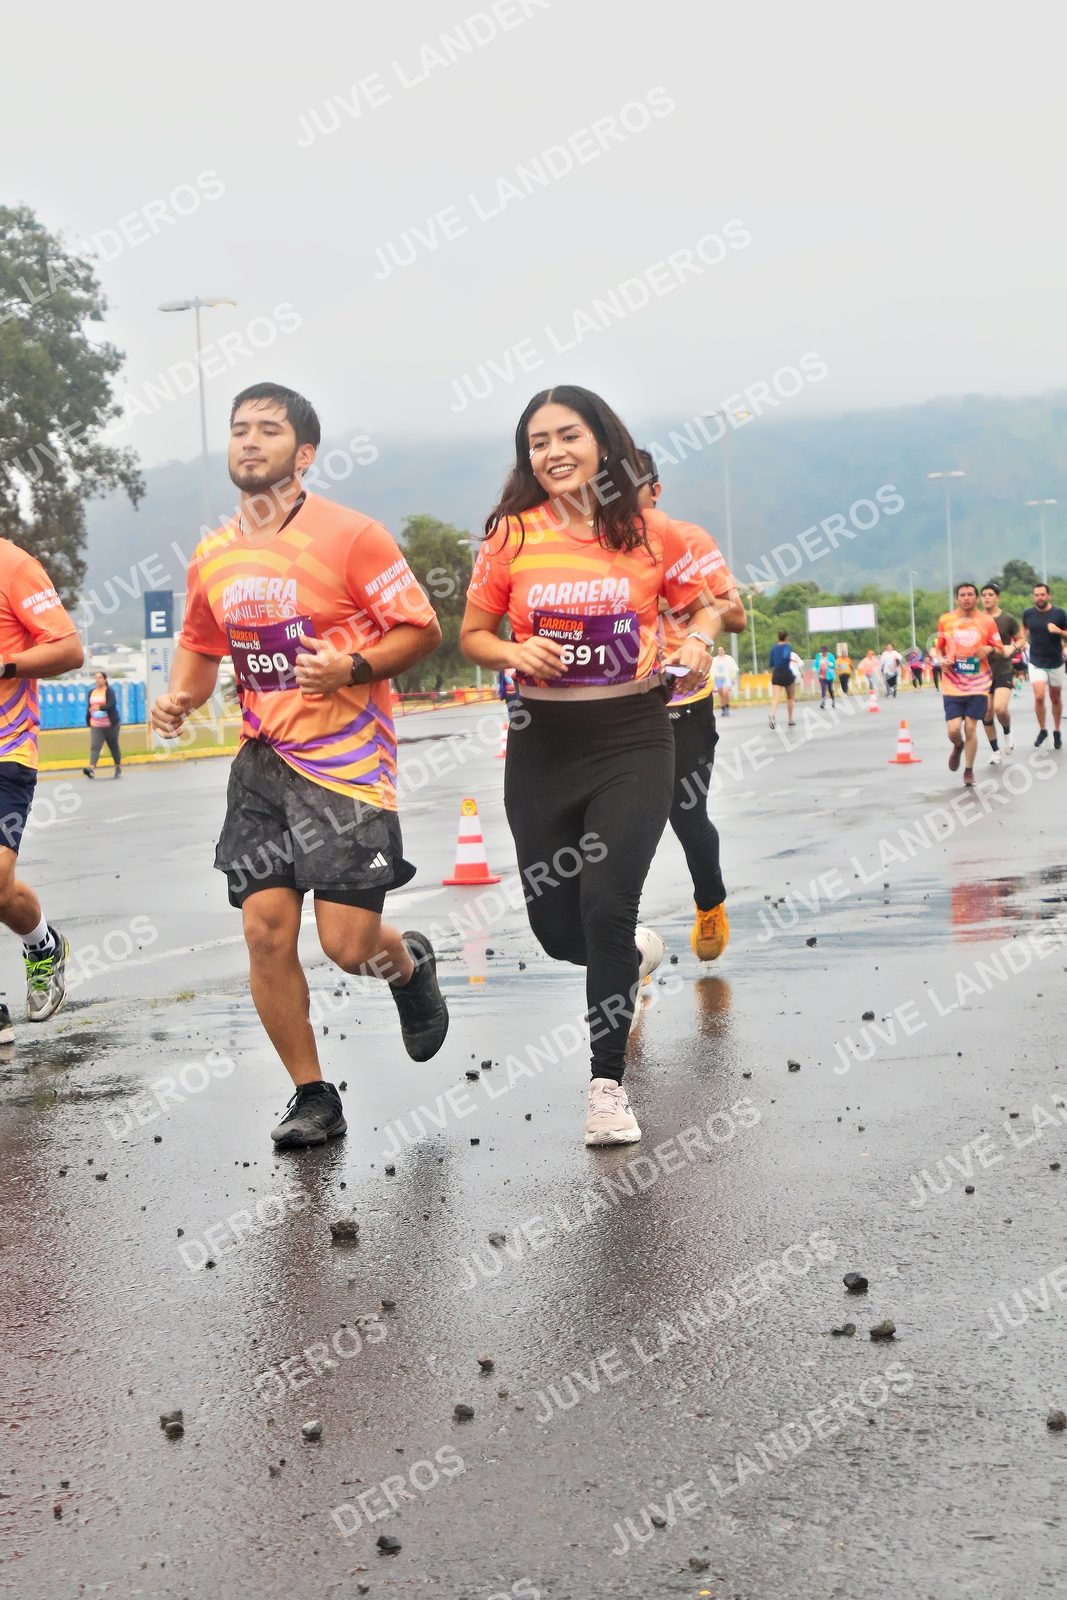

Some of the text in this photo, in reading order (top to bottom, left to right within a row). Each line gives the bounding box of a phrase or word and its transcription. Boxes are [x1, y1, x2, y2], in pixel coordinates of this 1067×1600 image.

[222, 576, 297, 610] CARRERA
[527, 577, 630, 608] CARRERA
[150, 610, 167, 633] E
[539, 616, 584, 631] CARRERA
[613, 618, 632, 634] 16K
[229, 628, 259, 641] CARRERA
[246, 652, 289, 673] 690
[559, 643, 606, 665] 691
